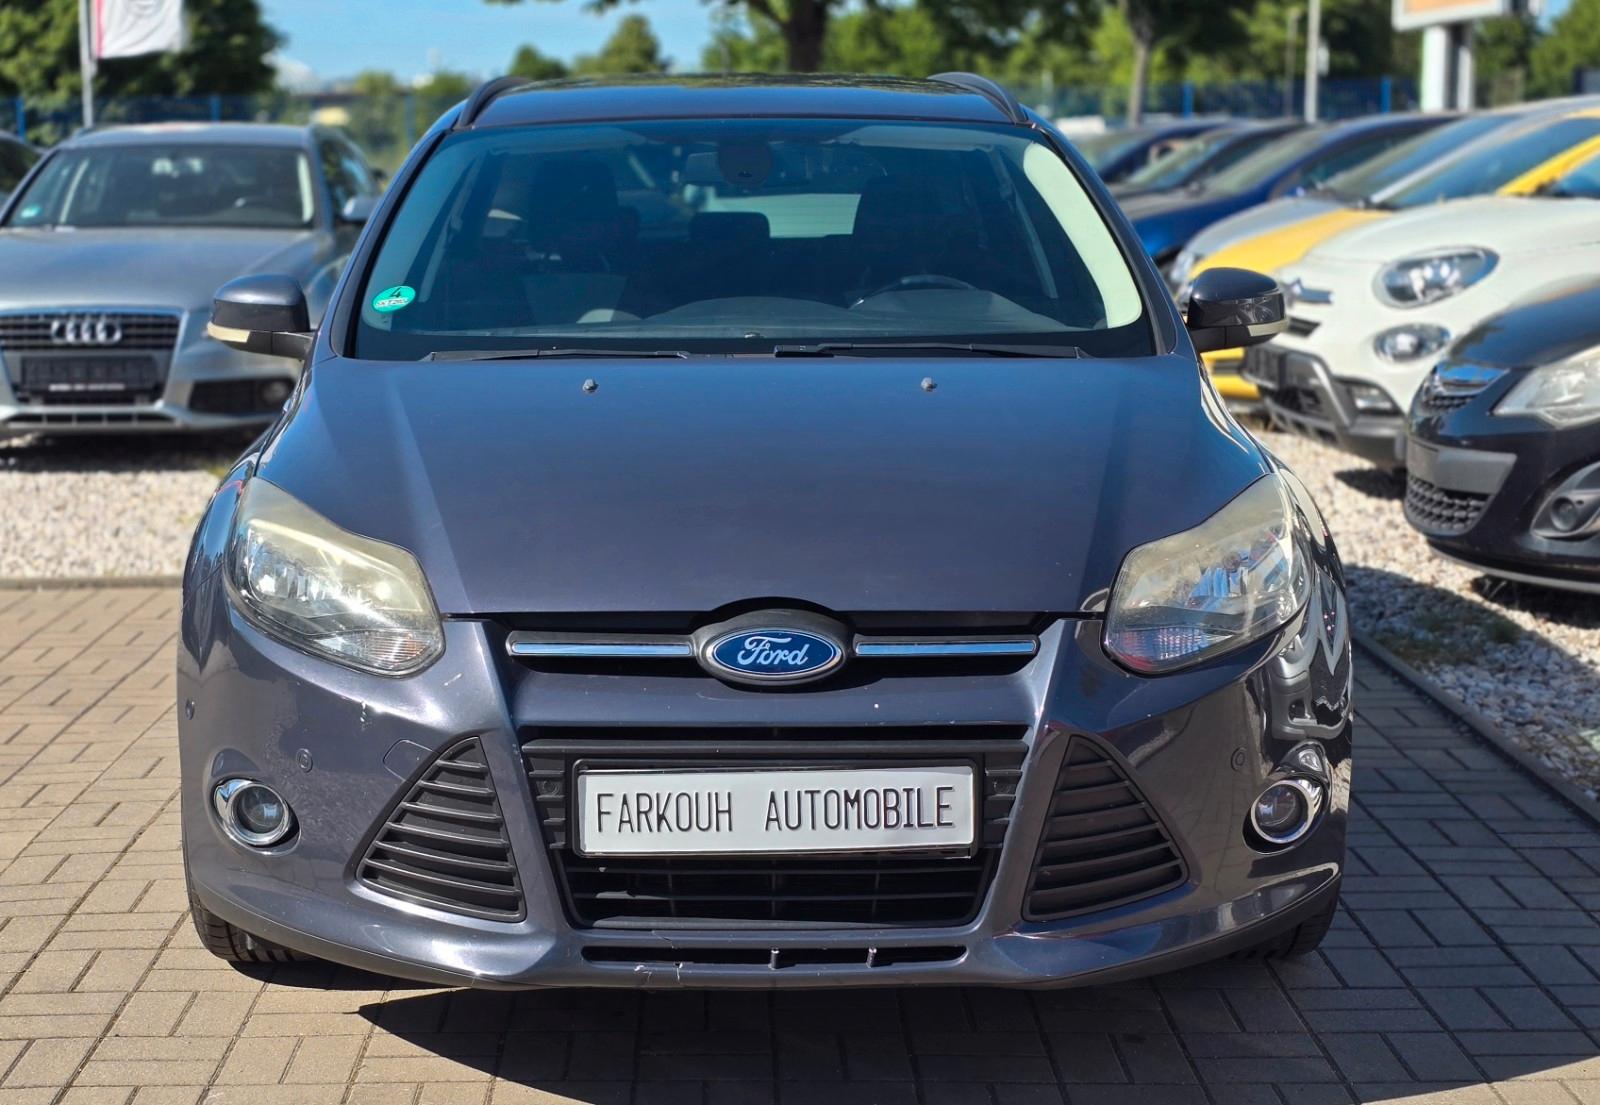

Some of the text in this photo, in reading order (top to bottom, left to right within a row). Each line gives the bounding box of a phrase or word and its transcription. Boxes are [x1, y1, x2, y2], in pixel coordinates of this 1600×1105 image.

[390, 287, 401, 298] 4
[737, 635, 809, 665] Ford
[596, 786, 954, 833] FARKOUH AUTOMOBILE
